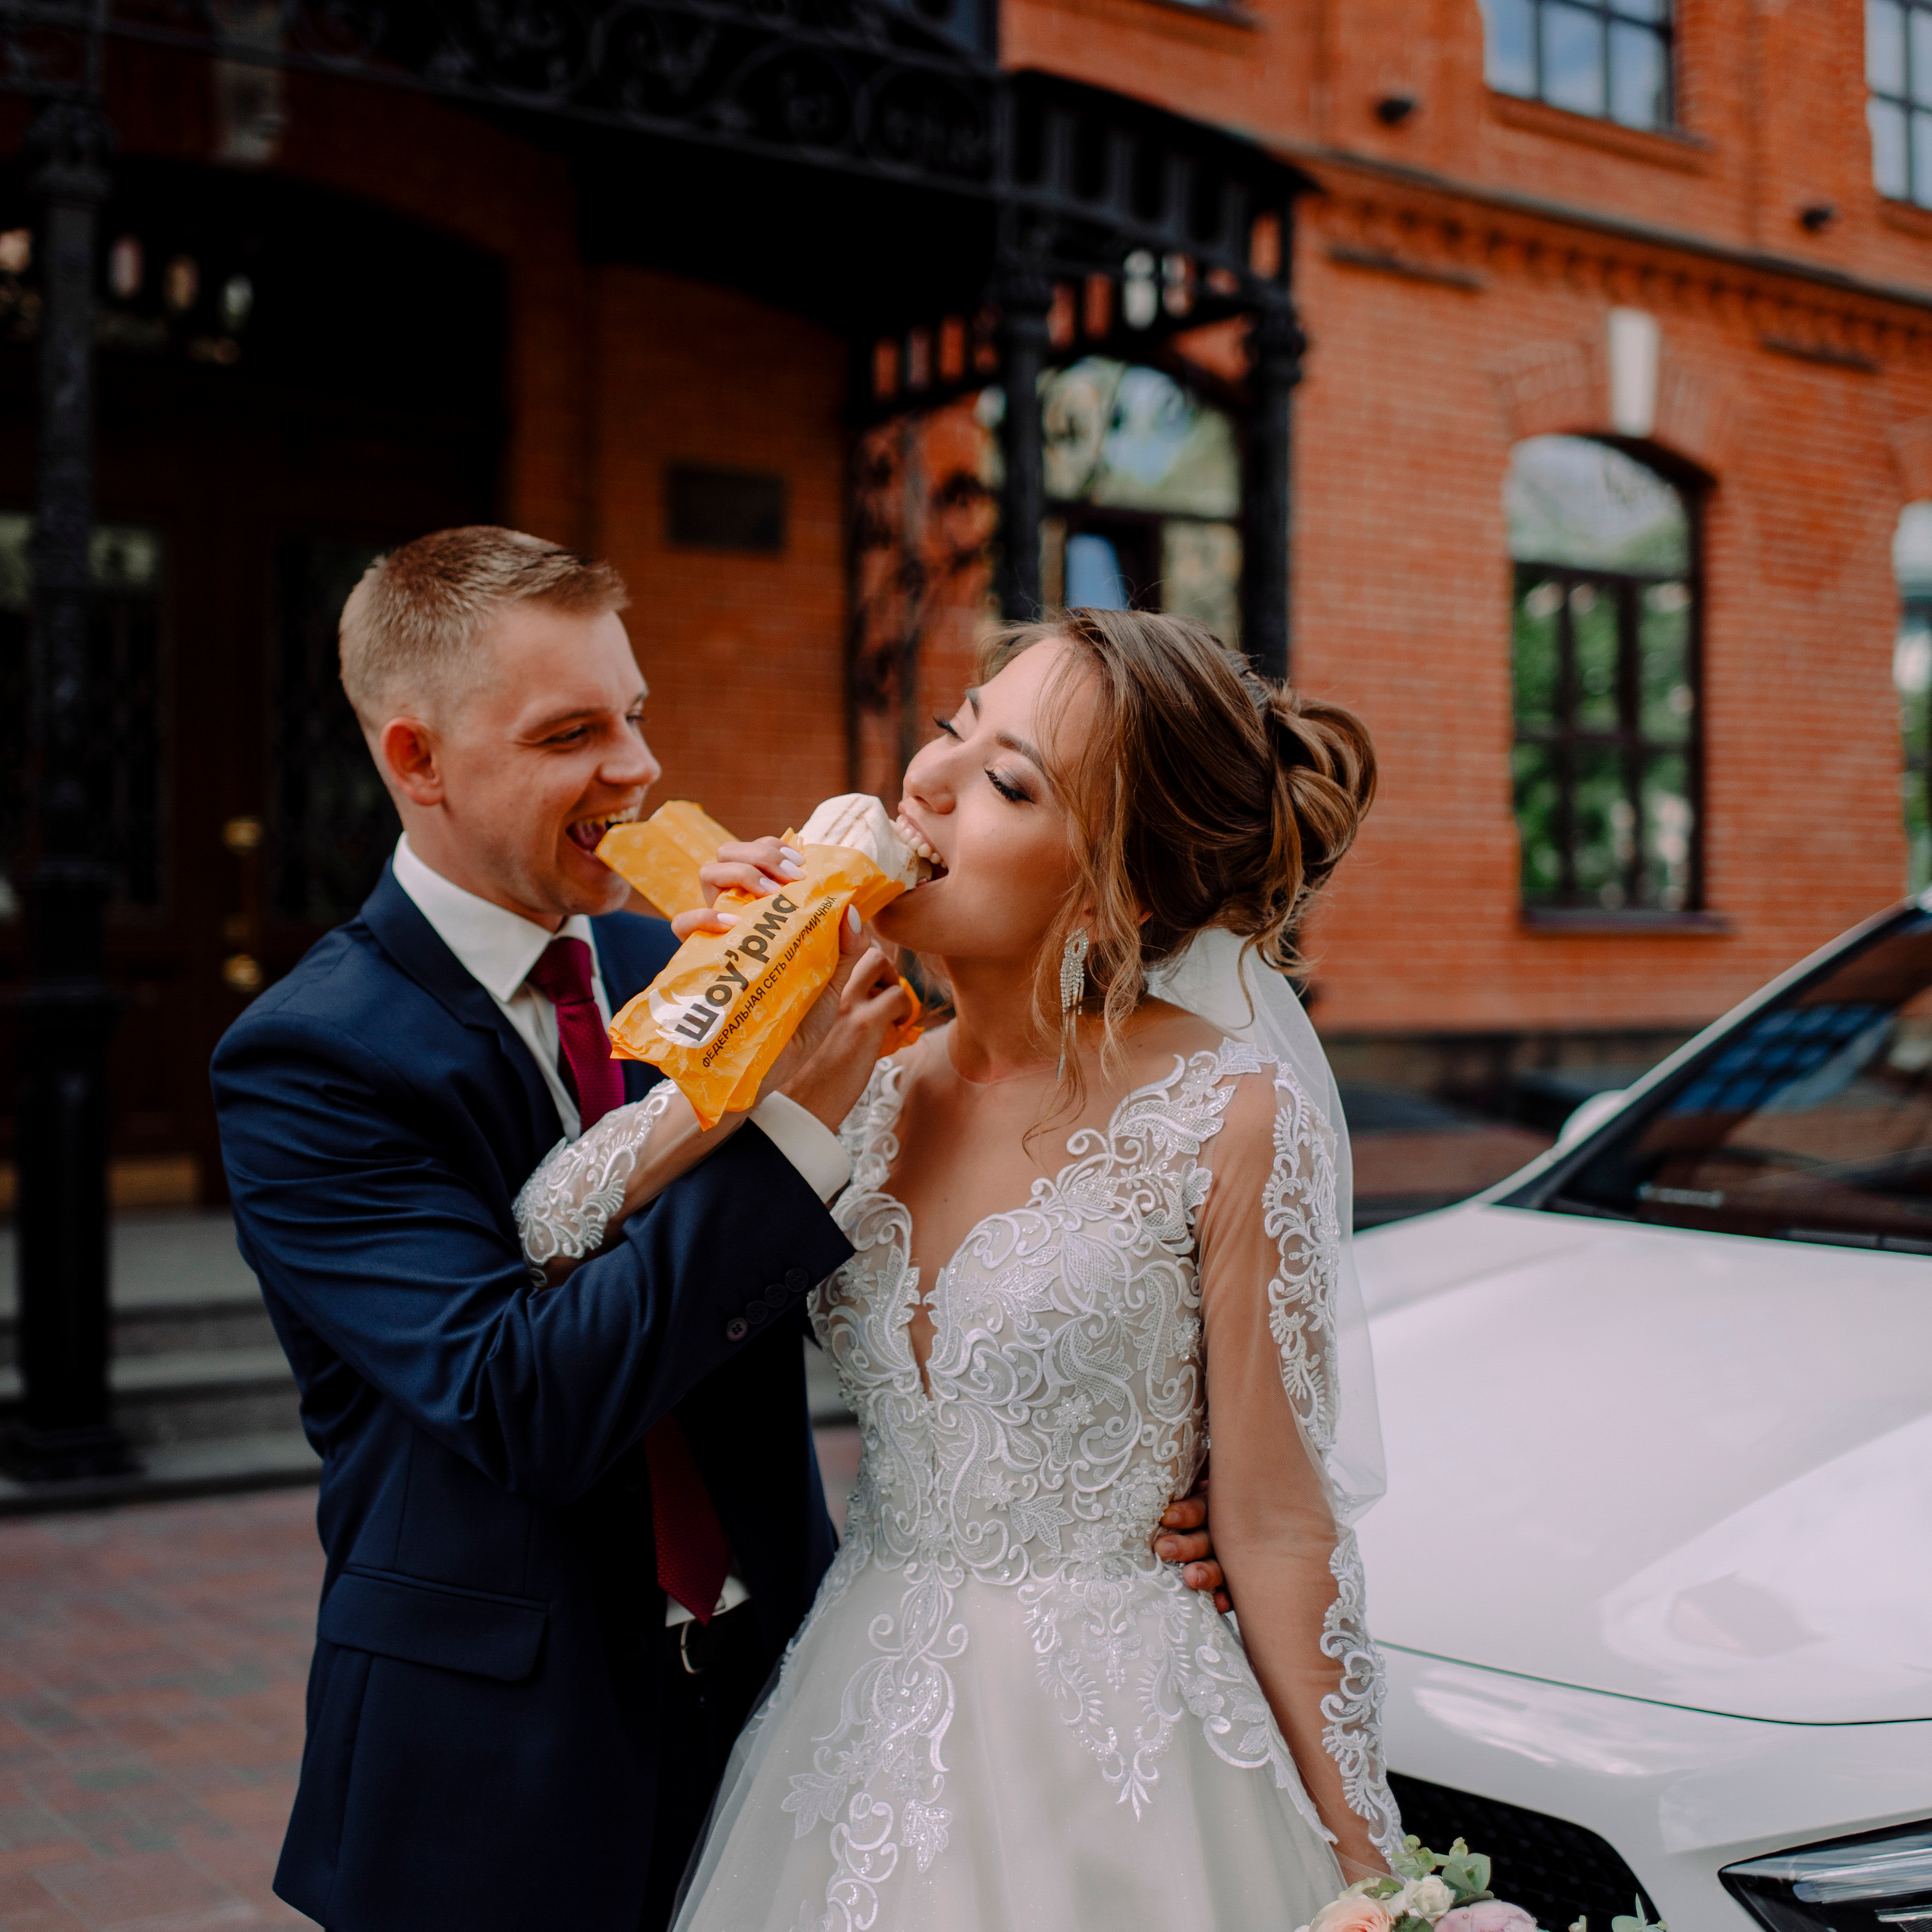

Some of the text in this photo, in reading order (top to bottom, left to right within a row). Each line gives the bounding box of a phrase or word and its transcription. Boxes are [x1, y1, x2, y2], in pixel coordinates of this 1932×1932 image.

[702, 896, 837, 1068] ФЕДЕРАЛЬНАЯ СЕТЬ ШАУРМИЧНЫХ
